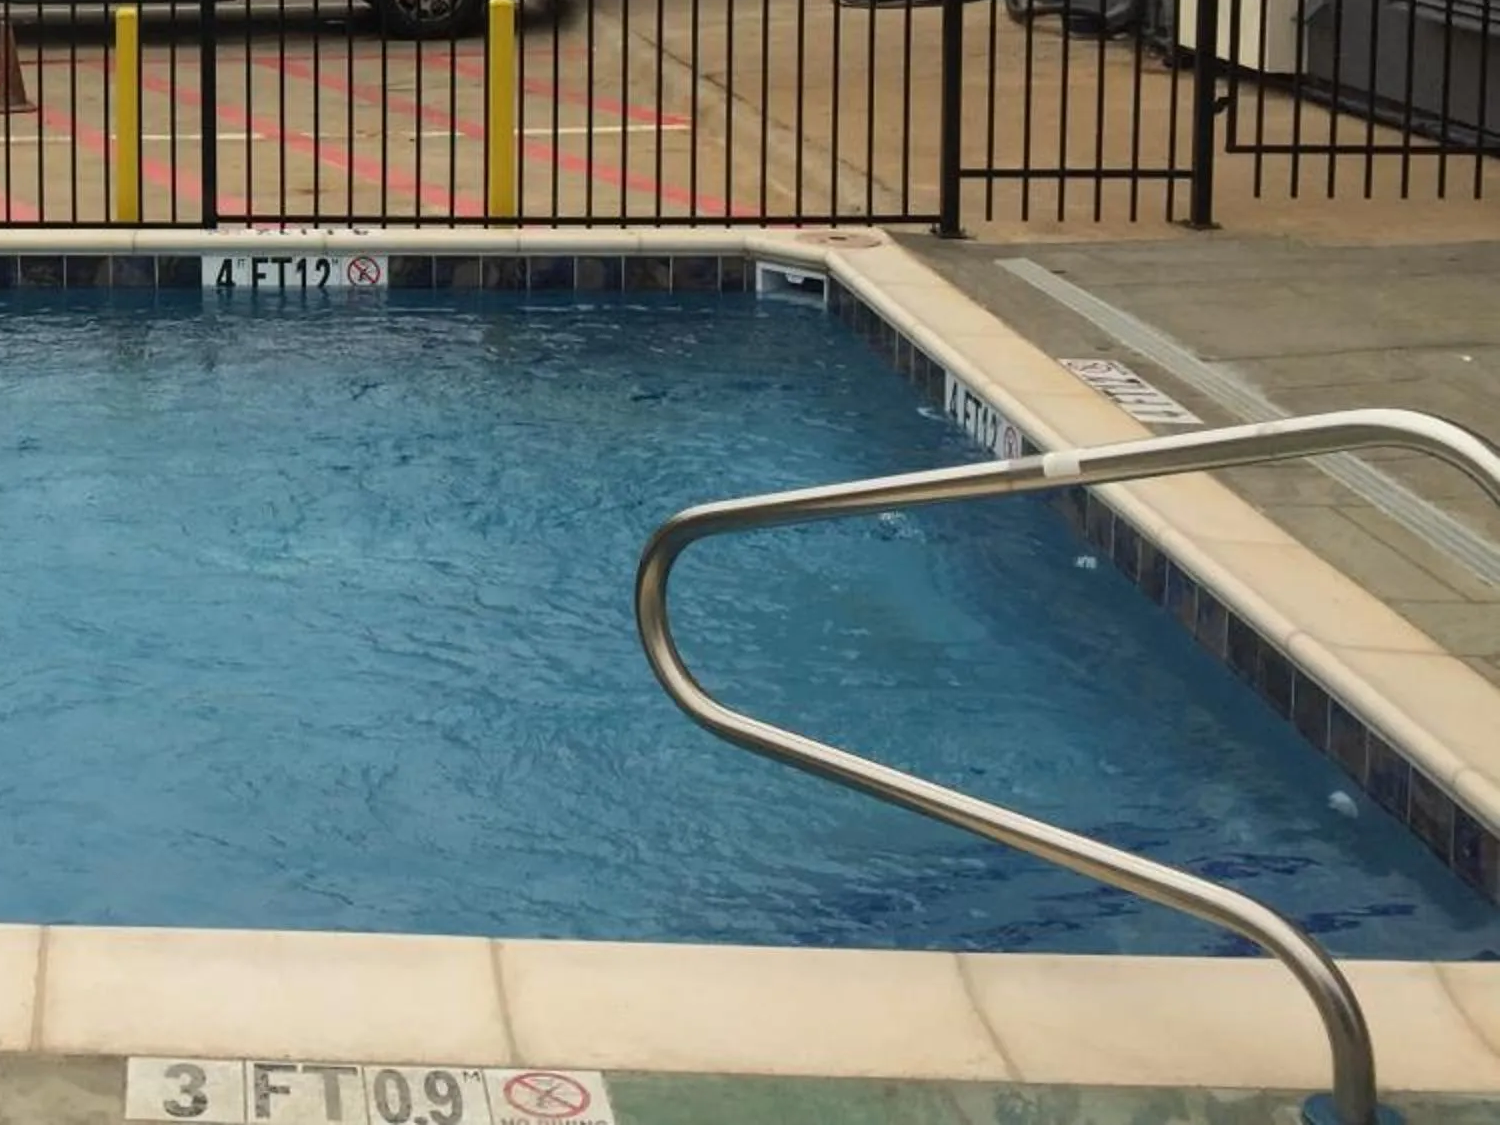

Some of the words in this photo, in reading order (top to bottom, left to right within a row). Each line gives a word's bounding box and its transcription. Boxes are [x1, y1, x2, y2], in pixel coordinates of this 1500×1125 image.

[215, 258, 236, 287] 4
[252, 256, 293, 288] FT
[163, 1062, 208, 1118] 3
[253, 1062, 359, 1122] FT
